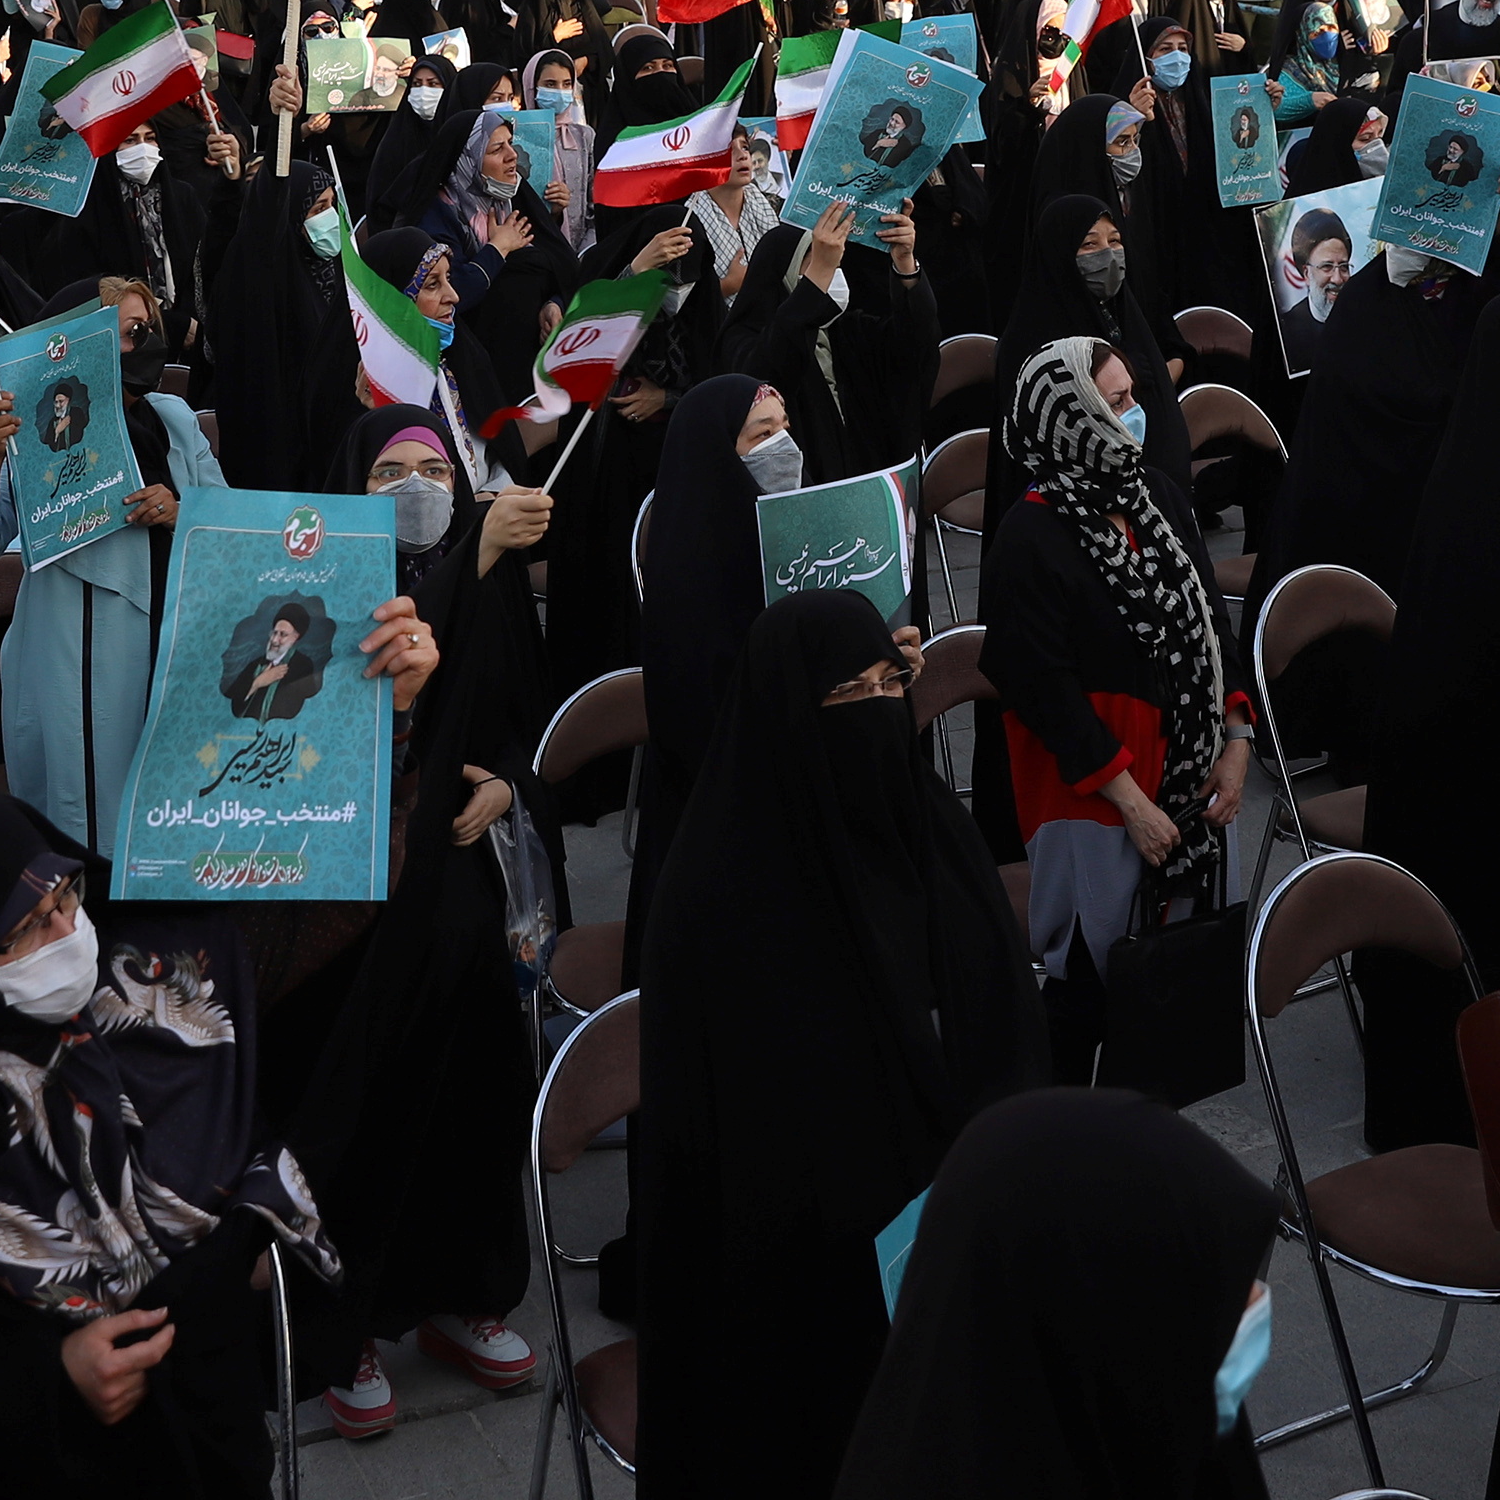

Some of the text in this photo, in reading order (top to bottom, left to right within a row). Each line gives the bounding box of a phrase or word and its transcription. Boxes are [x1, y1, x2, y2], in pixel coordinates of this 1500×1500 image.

[1390, 205, 1486, 238] #منتخب_جوانان_ایران
[30, 471, 125, 524] #منتخب_جوانان_ایران
[284, 513, 321, 553] انجام
[146, 800, 358, 829] #منتخب_جوانان_ایران
